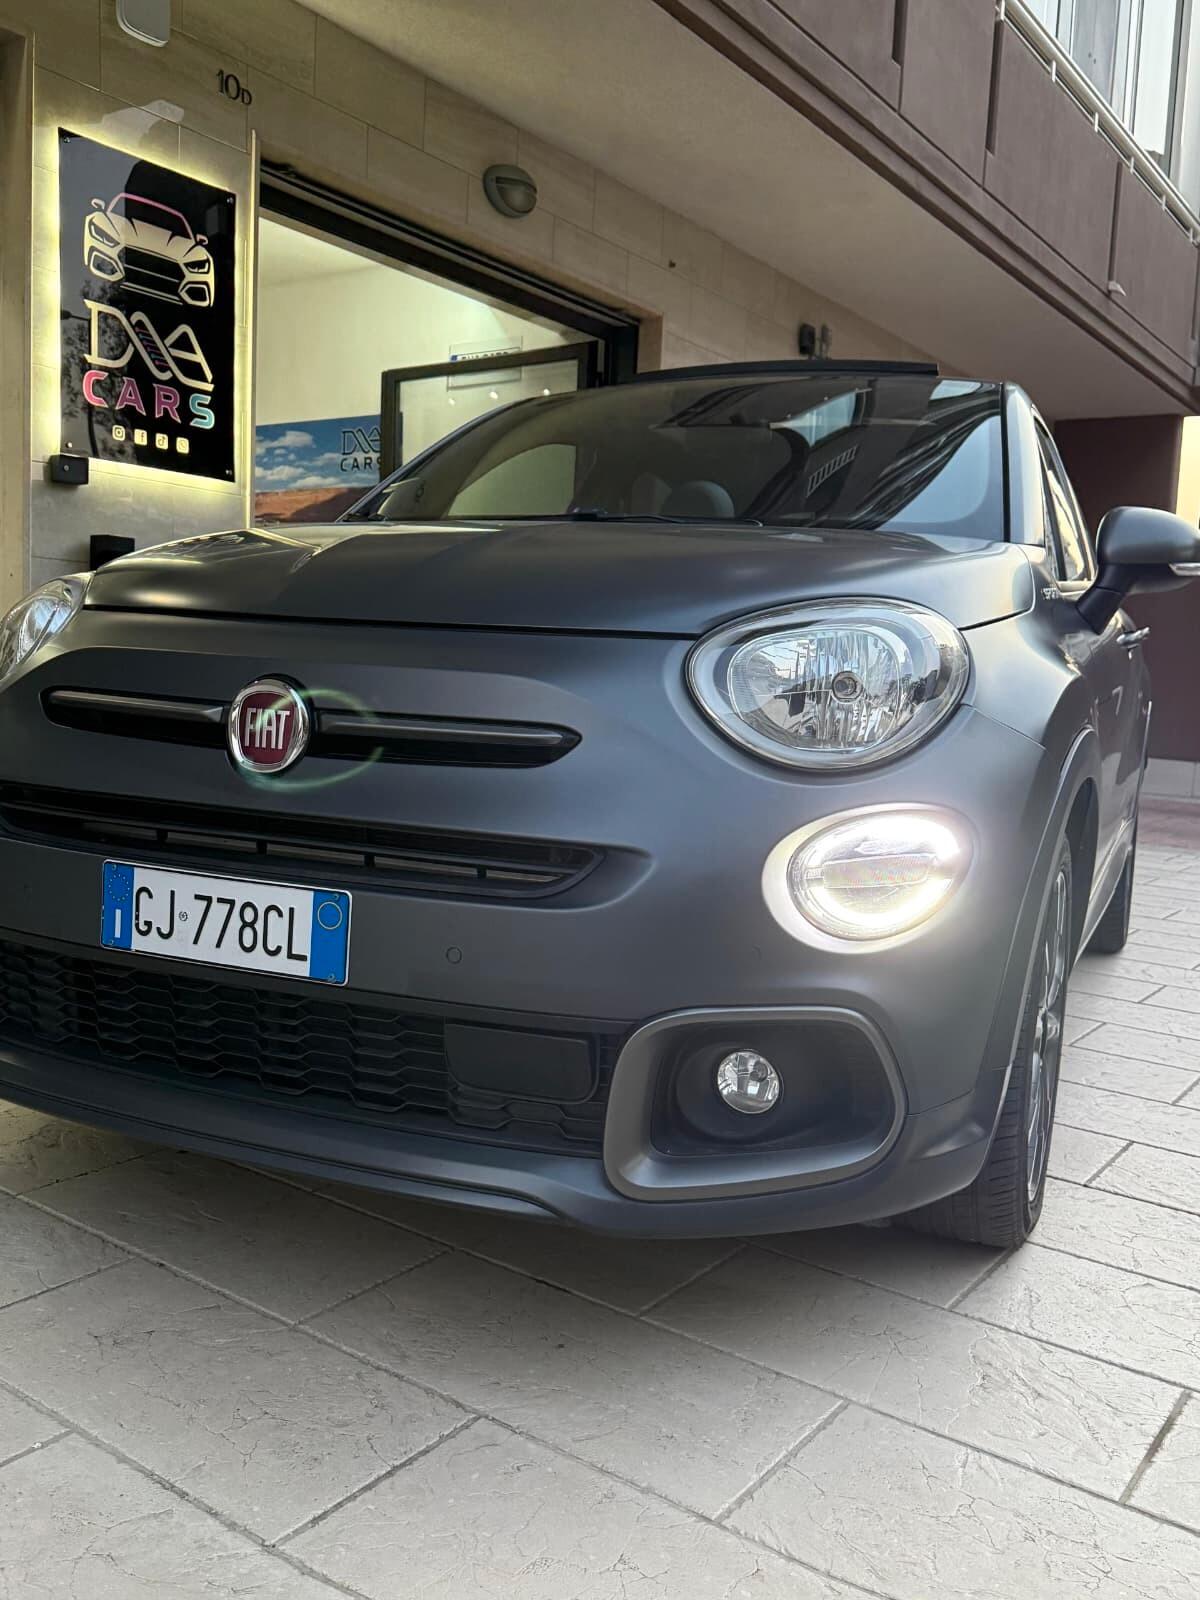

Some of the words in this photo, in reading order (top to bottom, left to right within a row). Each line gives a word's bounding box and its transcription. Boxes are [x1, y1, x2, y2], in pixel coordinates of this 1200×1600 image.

[84, 299, 215, 392] DNA
[82, 369, 215, 430] CARS
[244, 707, 291, 750] FIAT
